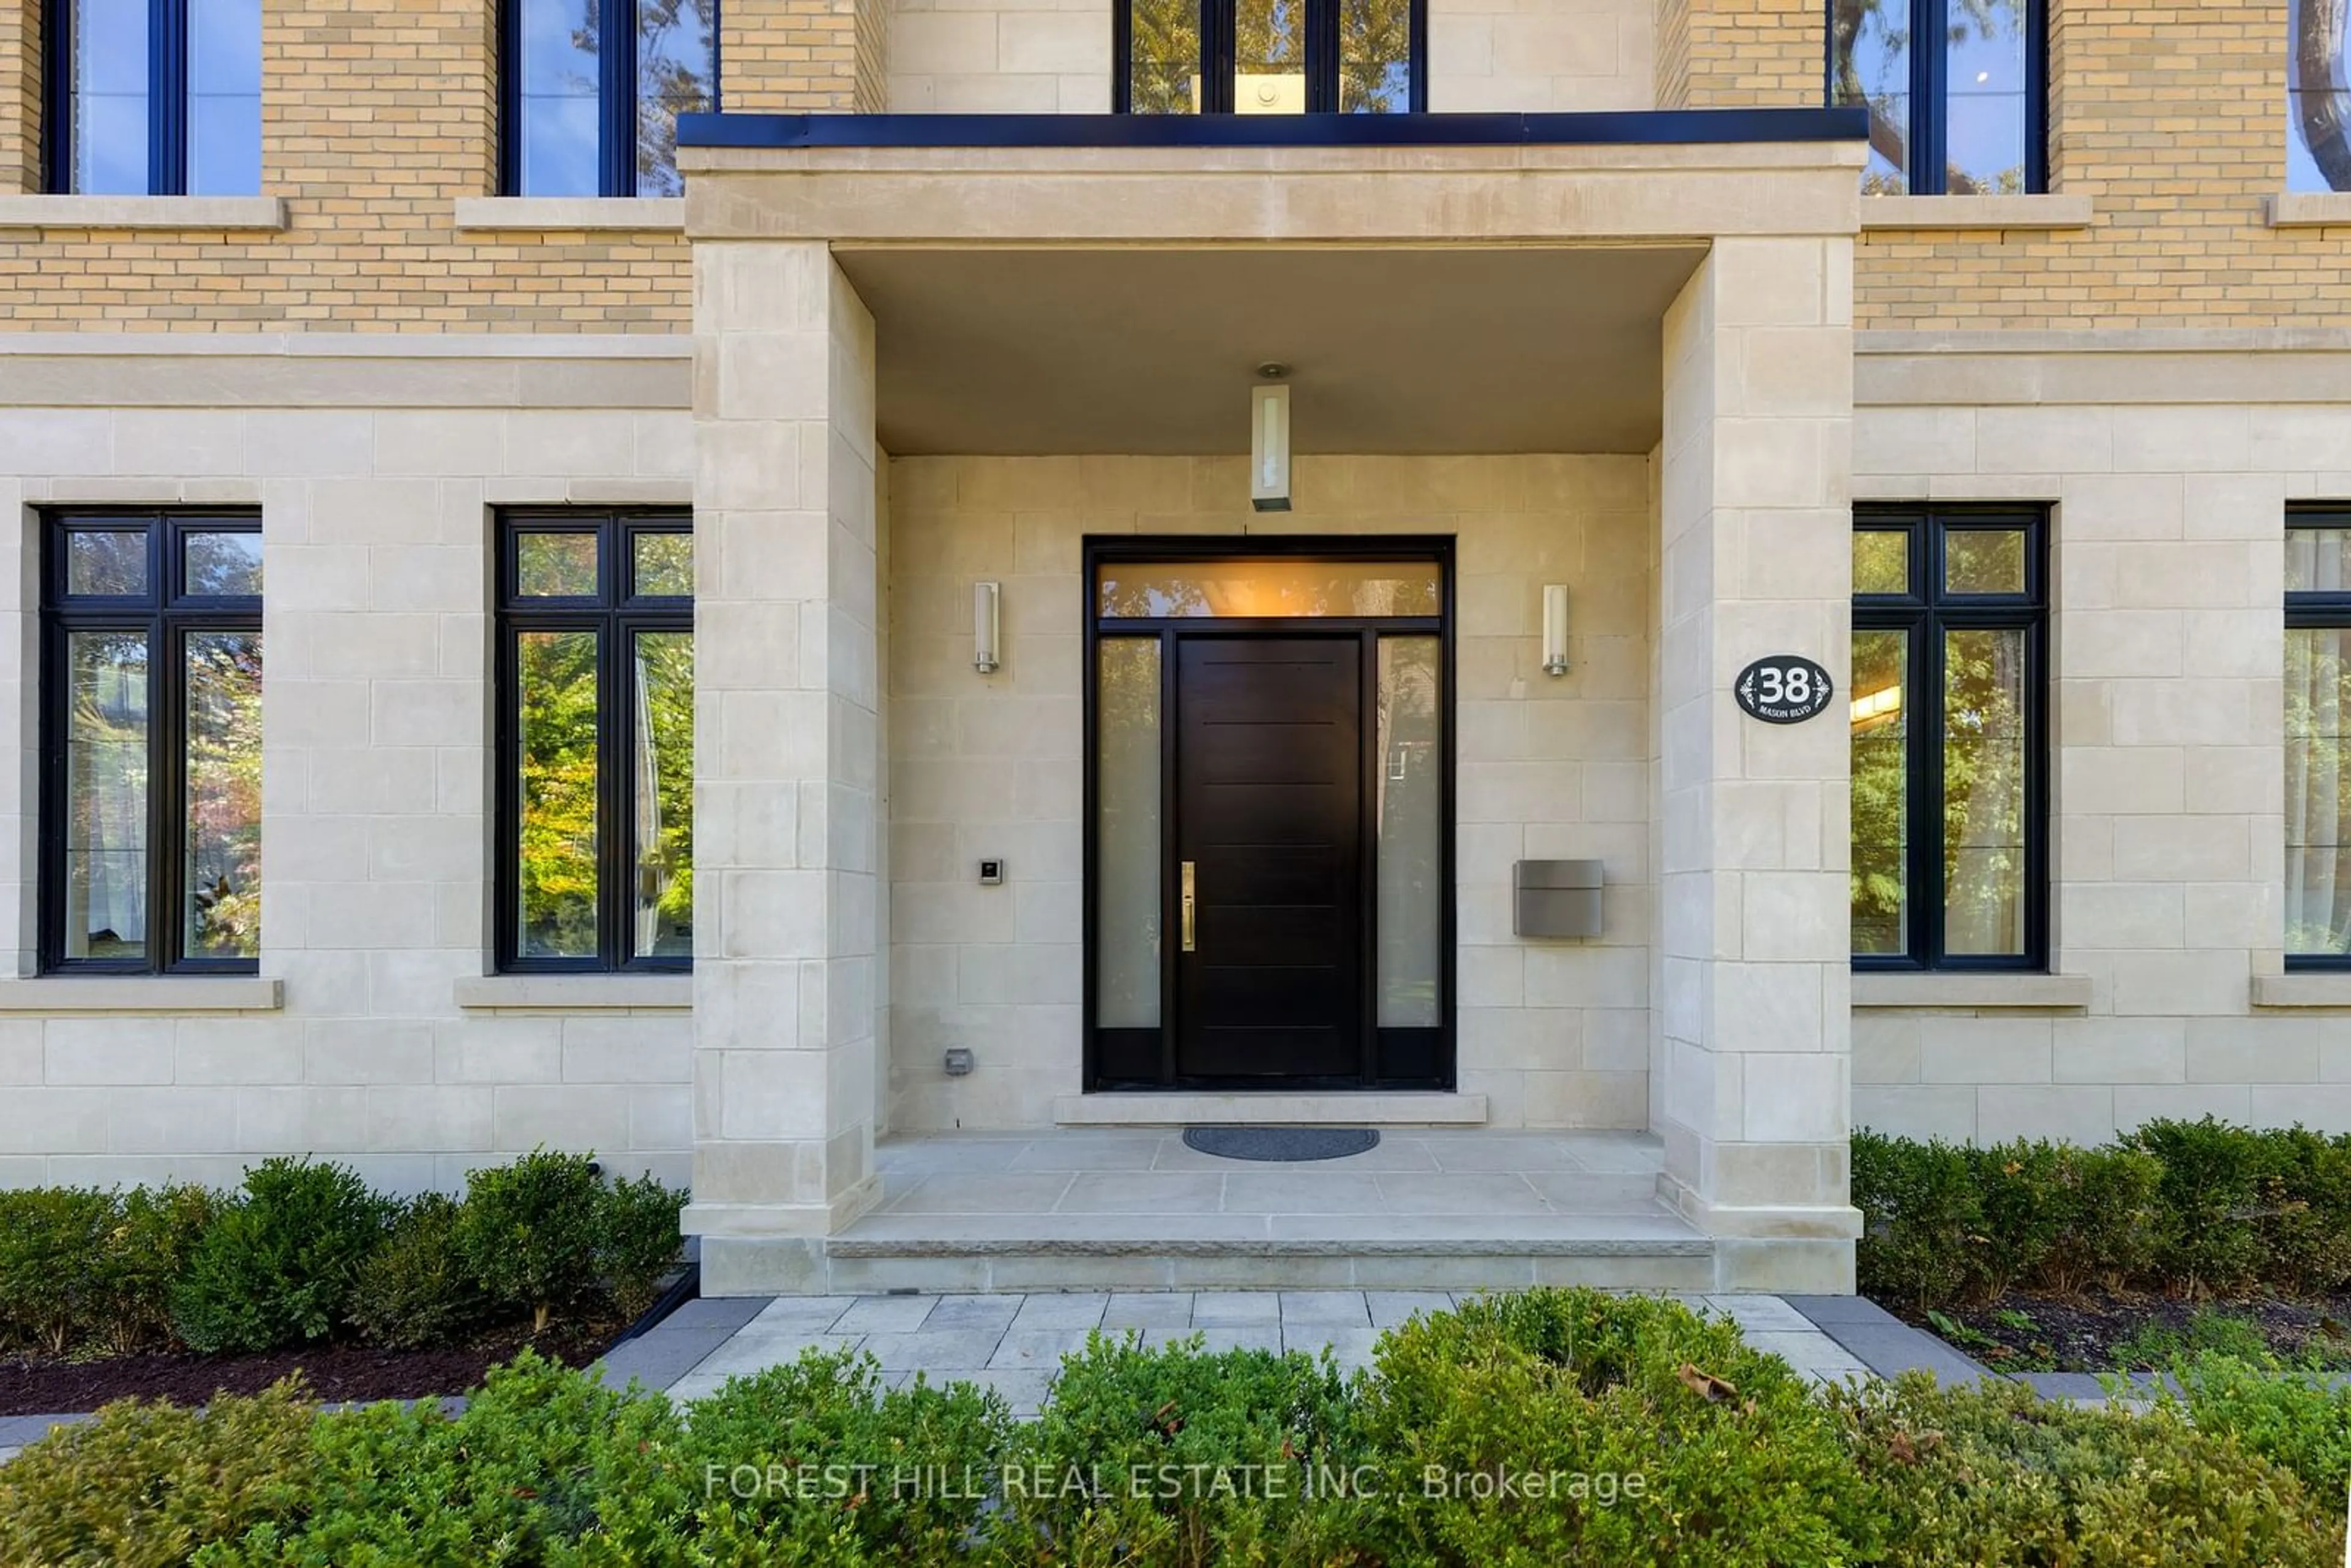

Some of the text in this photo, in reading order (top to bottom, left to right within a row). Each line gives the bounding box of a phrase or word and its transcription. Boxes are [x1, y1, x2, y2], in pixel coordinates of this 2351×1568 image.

[1760, 667, 1810, 703] 38
[1759, 705, 1811, 718] MASON BLVD
